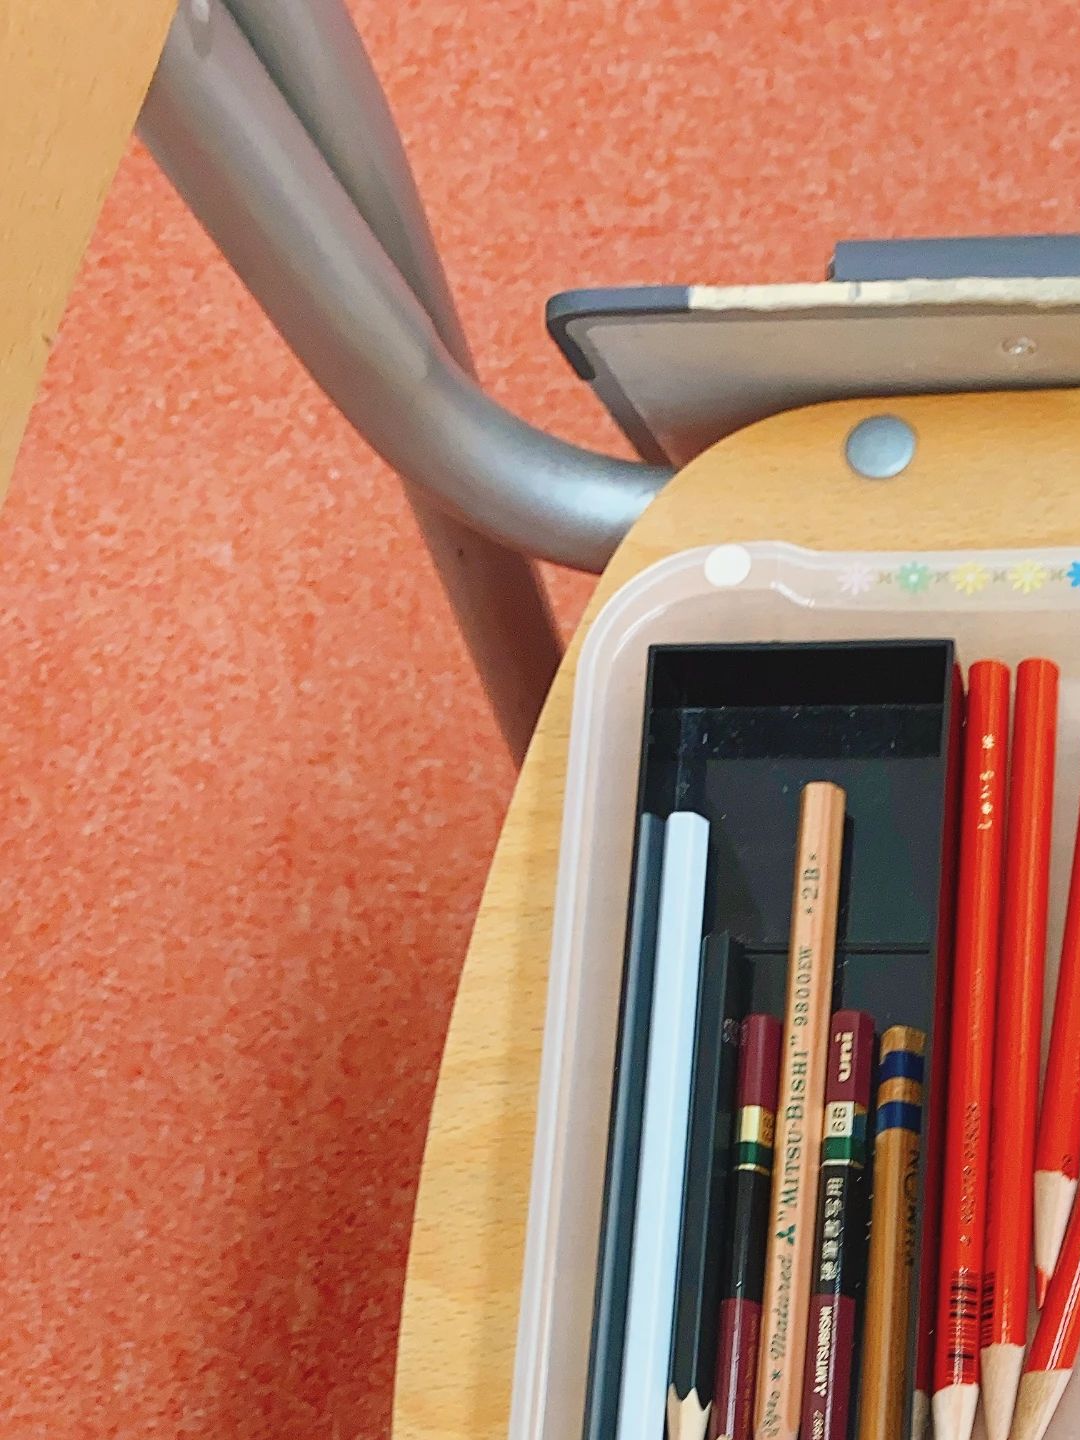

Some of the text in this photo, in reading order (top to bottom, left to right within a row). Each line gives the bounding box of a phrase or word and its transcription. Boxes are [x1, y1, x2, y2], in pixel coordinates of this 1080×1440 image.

[802, 868, 820, 900] 2B
[835, 1032, 853, 1082] uni
[830, 1106, 847, 1132] 6B
[815, 1306, 833, 1384] MITSUBISHI
